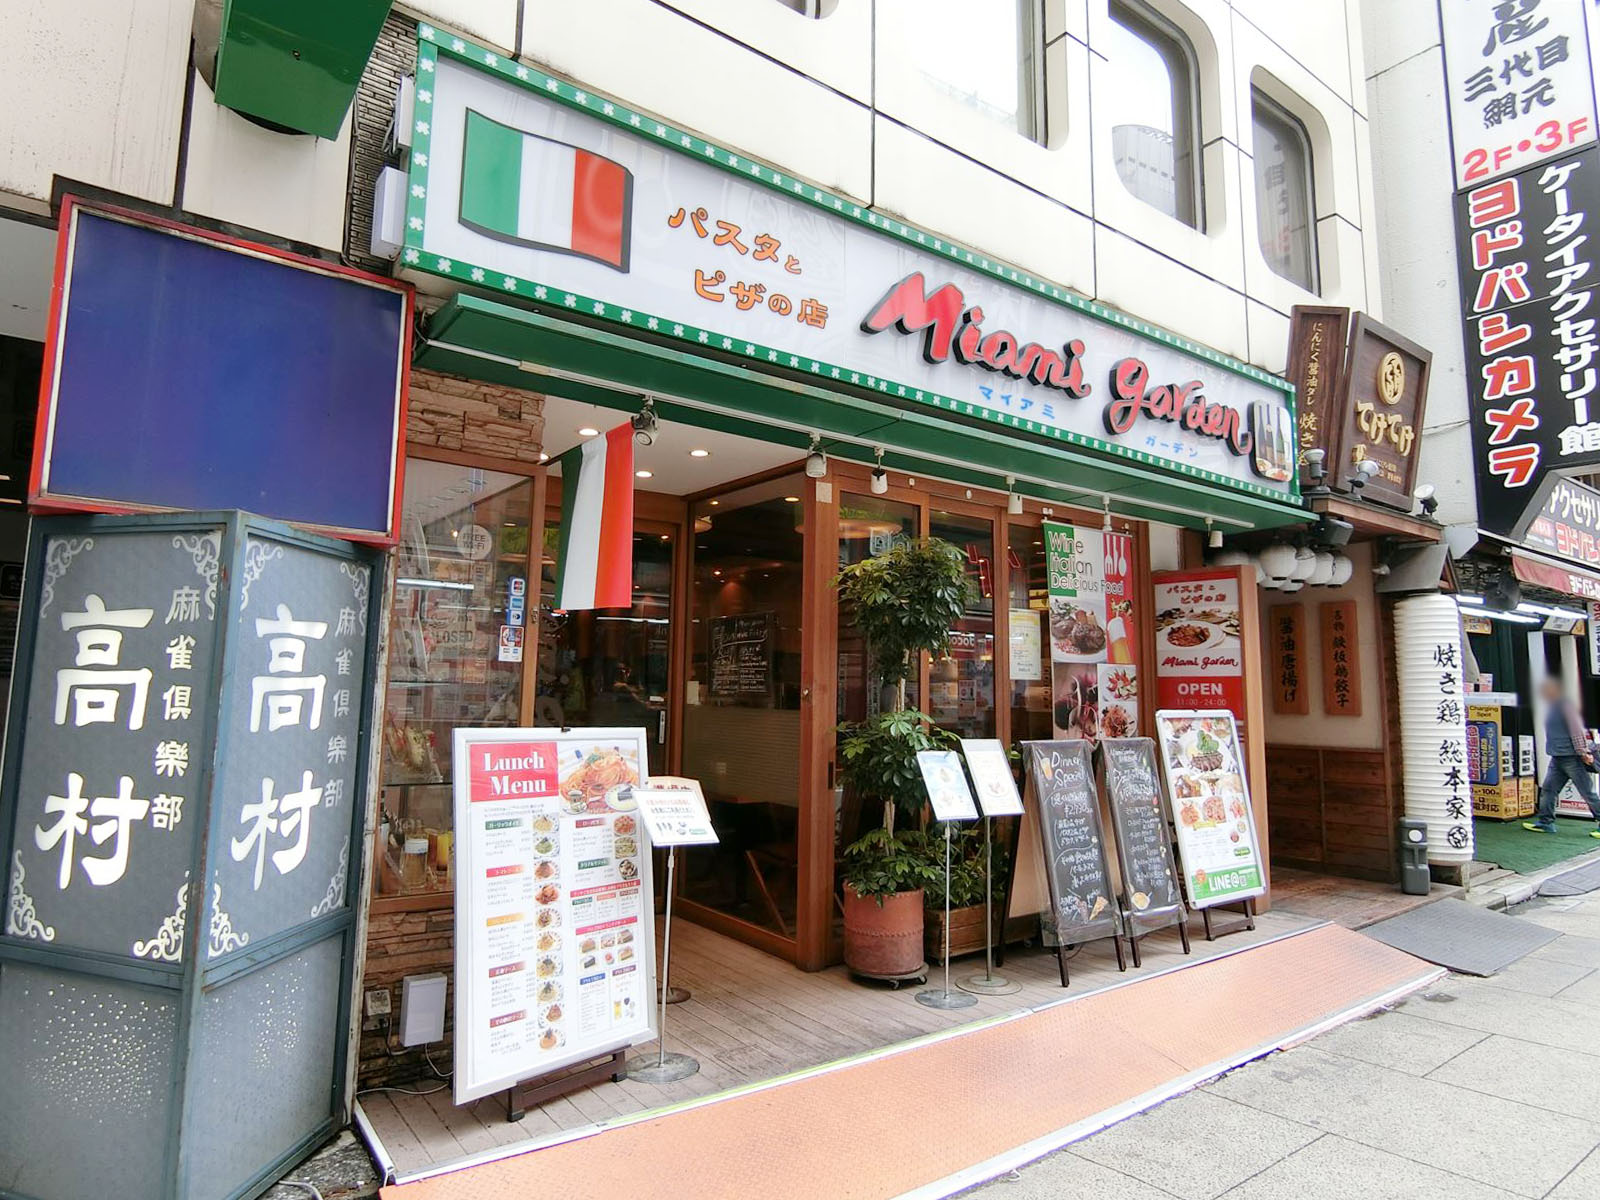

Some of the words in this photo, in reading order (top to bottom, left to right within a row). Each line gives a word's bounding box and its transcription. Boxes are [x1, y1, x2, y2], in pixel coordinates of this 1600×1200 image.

[1464, 35, 1569, 102] 三代目
[1483, 77, 1556, 129] 網元
[668, 207, 803, 276] パスタと
[693, 269, 829, 329] ピザの店
[1538, 161, 1600, 456] ケータイアクセサリー館
[860, 271, 1091, 400] Miami
[1468, 177, 1541, 488] ヨドバシカメラ
[1306, 322, 1323, 405] にんにく醤油タレ
[978, 385, 1055, 420] マイアミ
[1145, 435, 1199, 459] ガーデン
[1048, 531, 1084, 554] Wine
[1050, 552, 1093, 577] Italian
[1050, 572, 1098, 592] Delicious
[1100, 579, 1124, 596] Food
[1161, 656, 1200, 668] Miami
[1433, 643, 1462, 726] 焼き鶏
[1177, 682, 1223, 696] OPEN
[1470, 705, 1499, 713] Charging
[35, 594, 154, 890] 高村
[231, 602, 328, 891] 高村
[483, 751, 545, 772] Lunch
[490, 775, 547, 796] Menu
[1439, 739, 1467, 820] 総本家
[1208, 872, 1239, 892] LINE@
